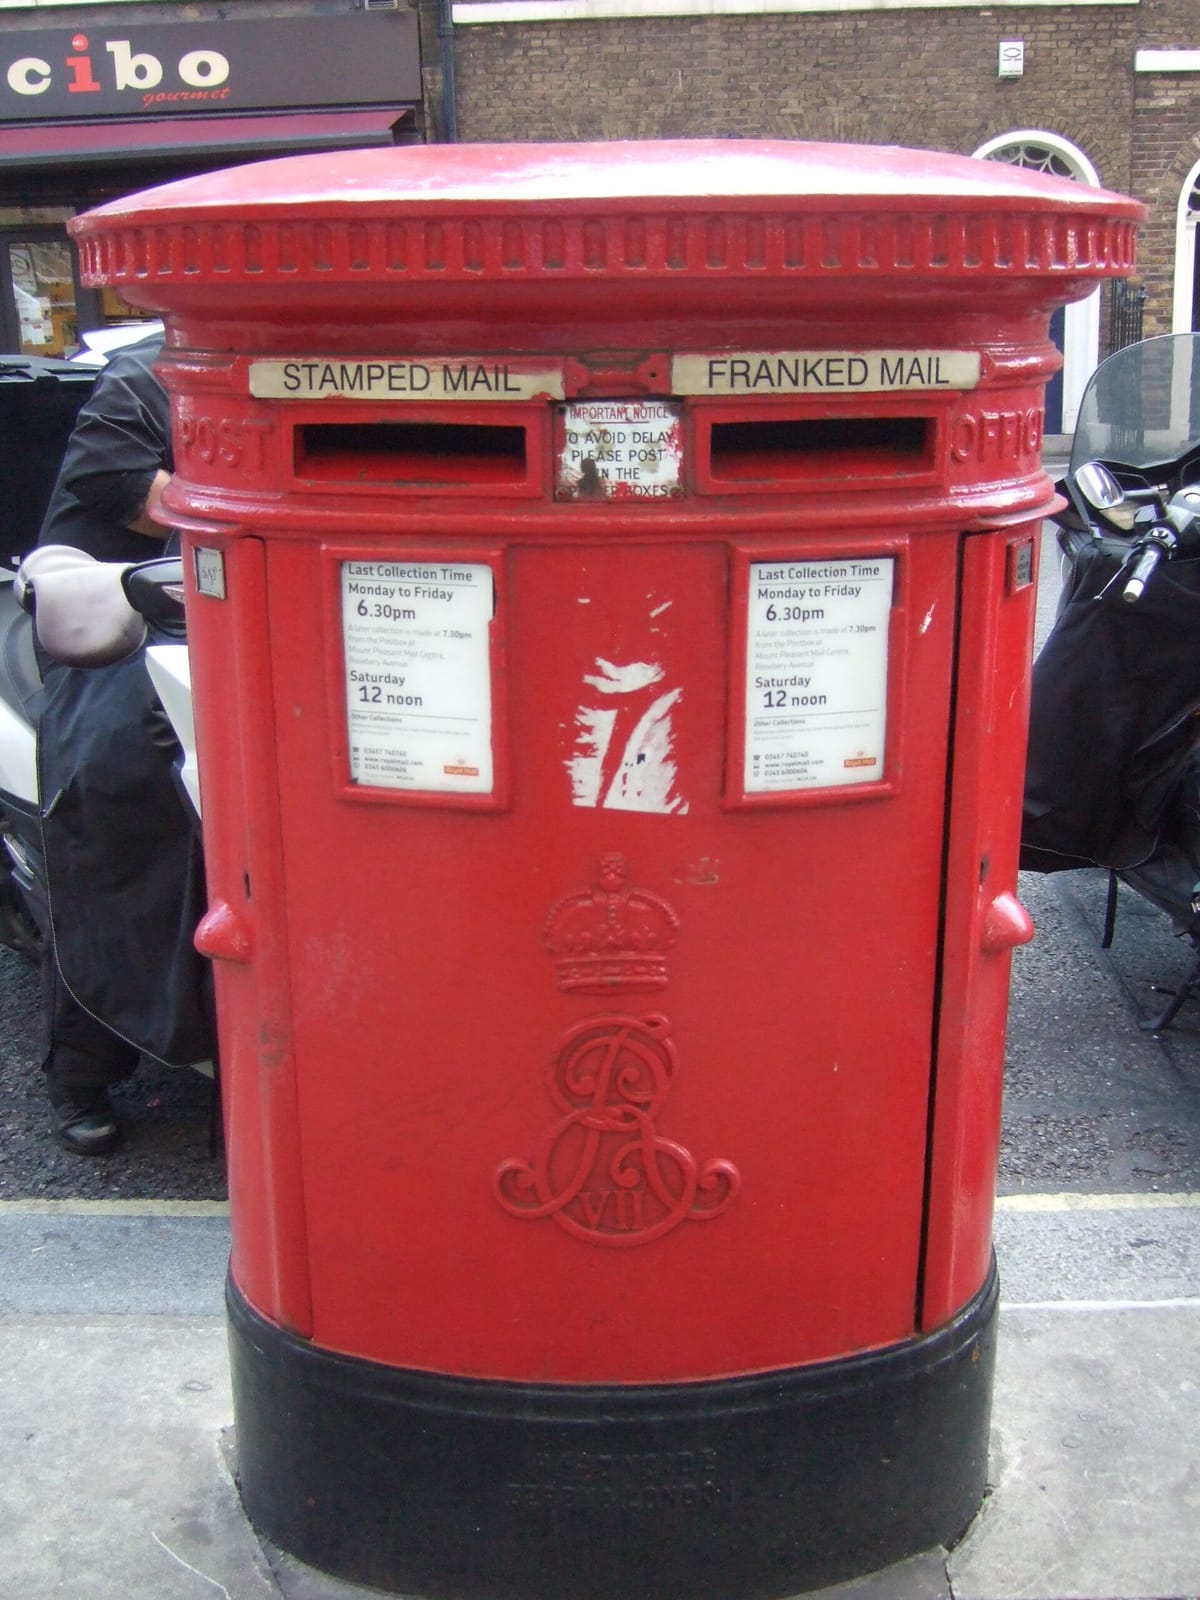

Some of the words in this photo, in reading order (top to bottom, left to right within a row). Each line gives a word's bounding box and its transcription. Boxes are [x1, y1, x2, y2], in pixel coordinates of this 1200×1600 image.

[7, 33, 230, 95] cibo
[143, 87, 231, 108] gourmet
[283, 363, 430, 391] STAMPED
[443, 364, 521, 391] MAIL
[708, 357, 868, 388] FRANKED
[880, 356, 949, 385] MAIL
[570, 407, 629, 419] IMPORTANT
[634, 406, 669, 419] NOTICE
[585, 431, 626, 444] AVOID
[633, 432, 673, 443] DELAY
[572, 449, 622, 462] PLEASE
[629, 449, 665, 462] POST
[616, 467, 640, 480] THE
[348, 563, 374, 577] Last
[377, 565, 437, 580] Collection
[440, 568, 472, 581] Time
[758, 569, 784, 581] Last
[788, 565, 847, 579] Collection
[850, 564, 880, 577] Time
[348, 583, 396, 598] Monday
[399, 587, 411, 597] to
[414, 586, 454, 601] Friday
[758, 586, 806, 600] Monday
[809, 587, 821, 597] to
[824, 584, 861, 598] Friday
[357, 599, 416, 621] 6.30pm
[766, 604, 824, 622] 6.30pm
[442, 629, 472, 639] 7.30pm
[848, 625, 876, 633] 7.30pm
[350, 671, 405, 687] Saturday
[755, 675, 811, 688] Saturday
[359, 685, 382, 703] 12
[387, 694, 423, 706] noon
[763, 690, 786, 708] 12
[791, 694, 827, 706] noon
